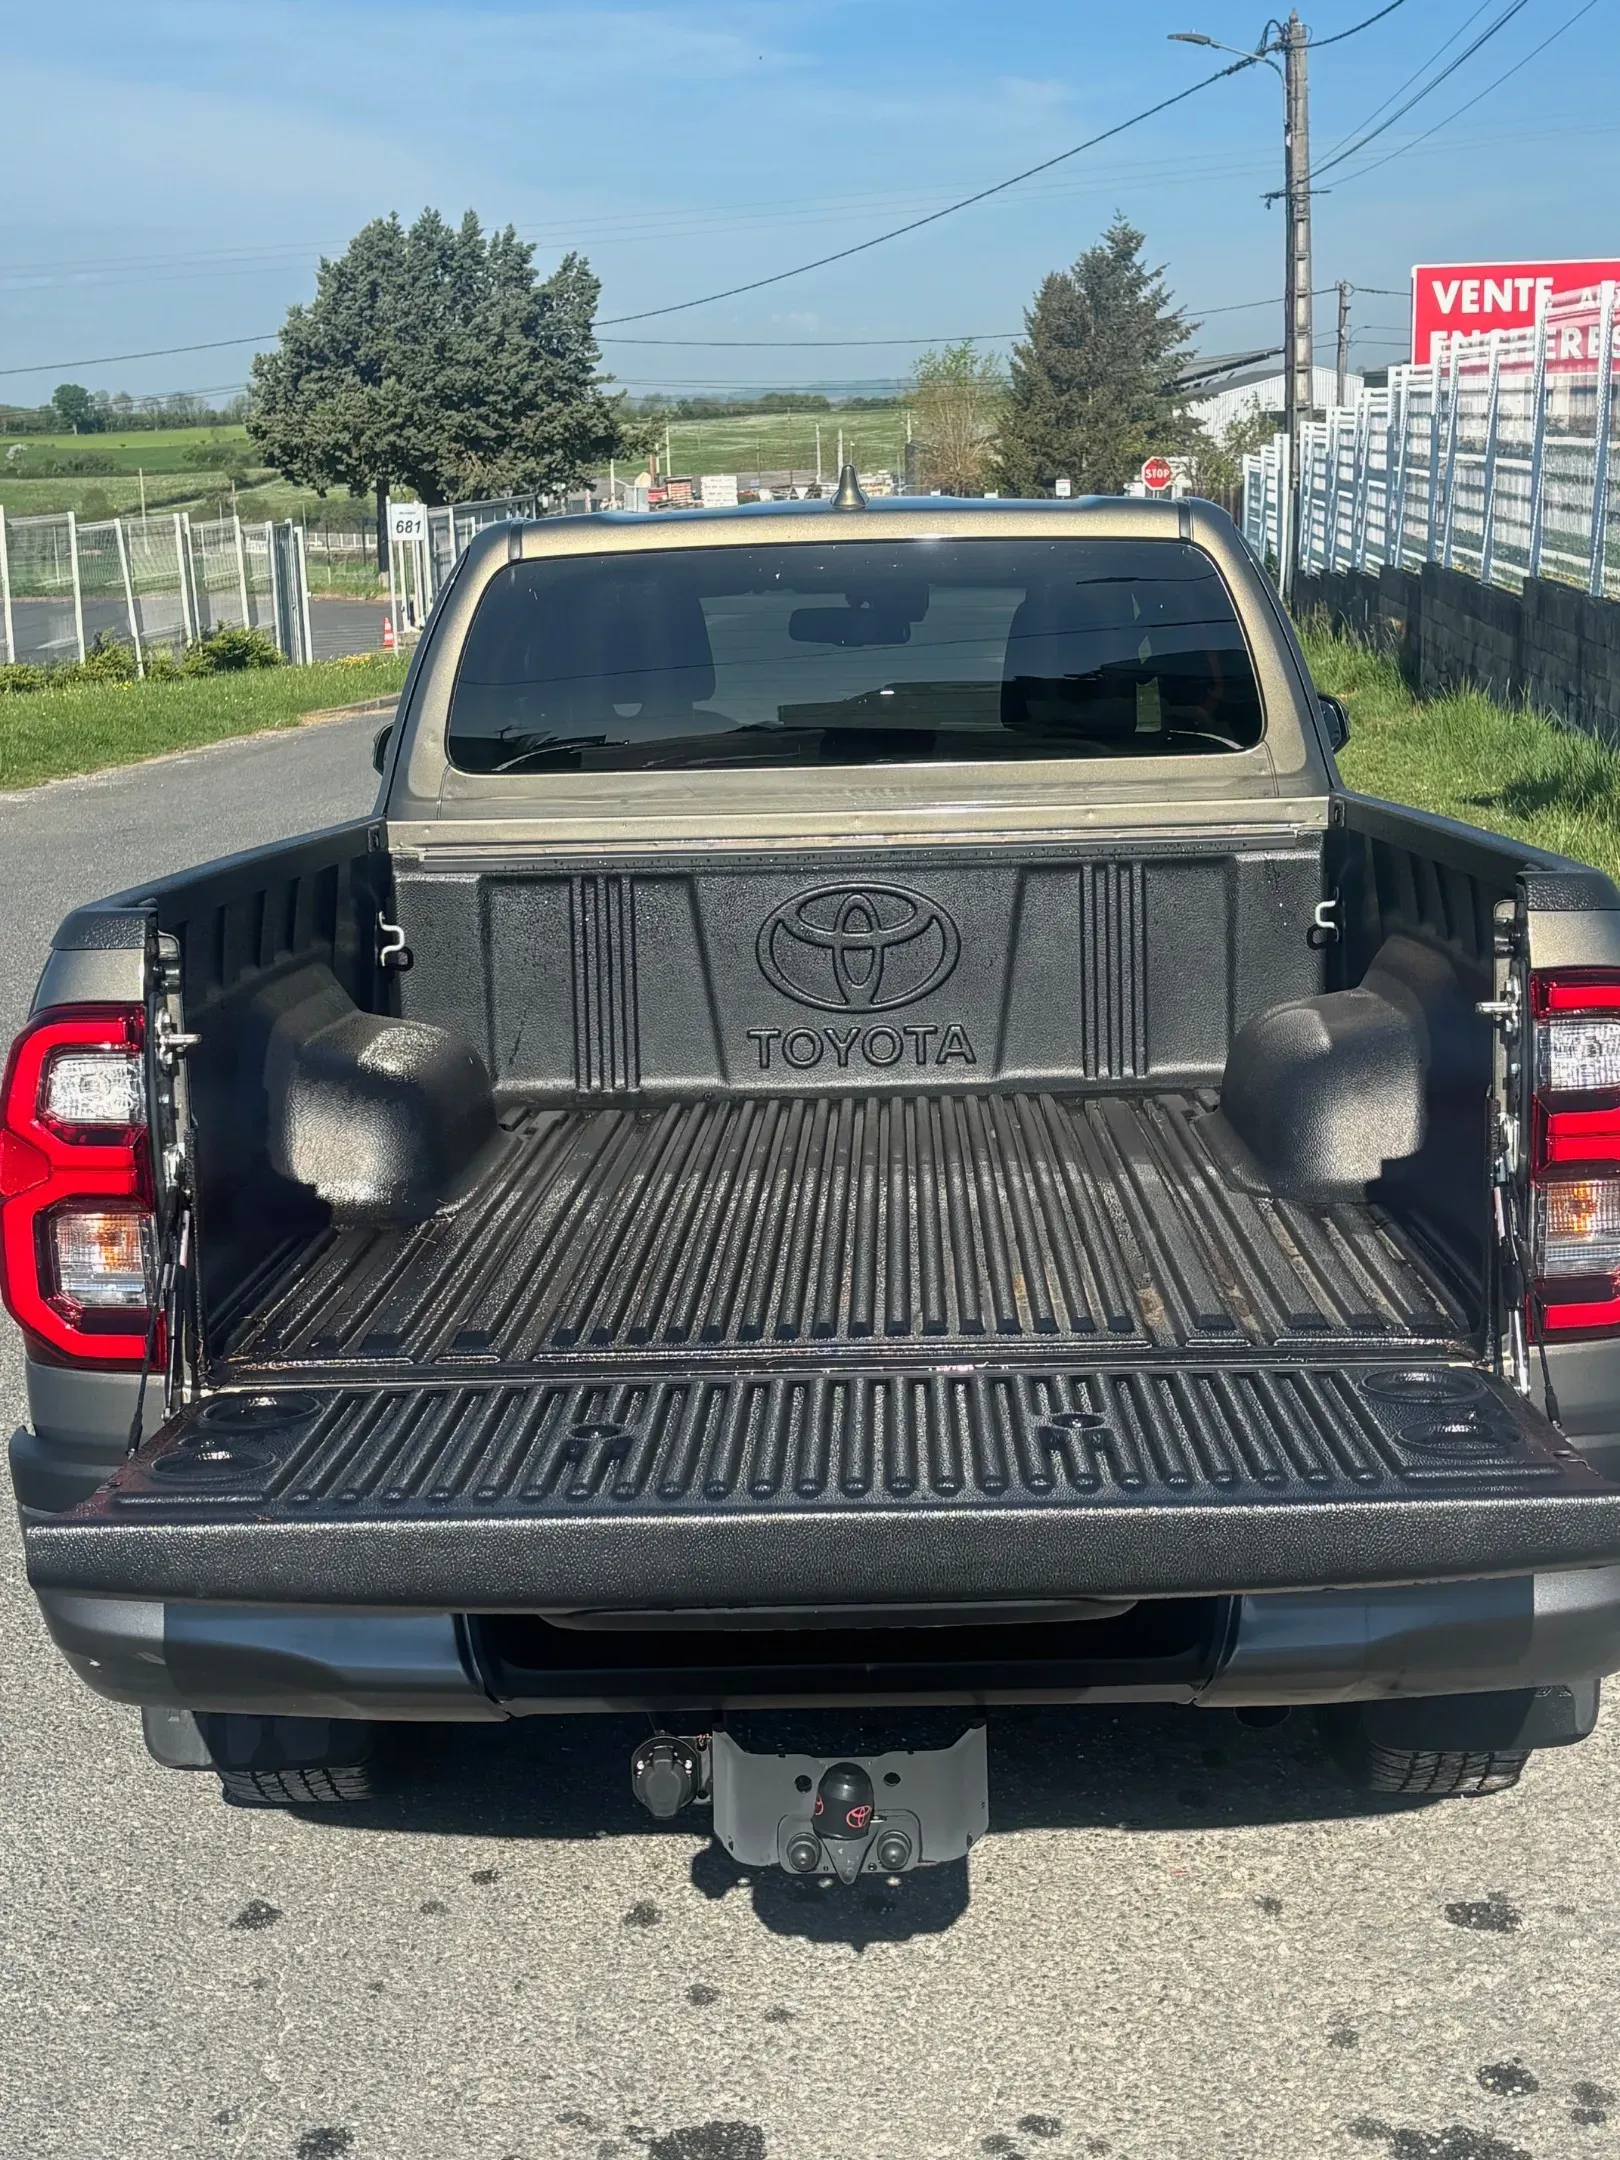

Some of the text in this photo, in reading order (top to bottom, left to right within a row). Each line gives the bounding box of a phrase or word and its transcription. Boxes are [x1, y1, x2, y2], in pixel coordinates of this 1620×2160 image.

[1432, 277, 1554, 314] VENTE
[1145, 468, 1170, 479] STOP
[396, 520, 421, 534] 681
[747, 1024, 977, 1070] TOYOTA
